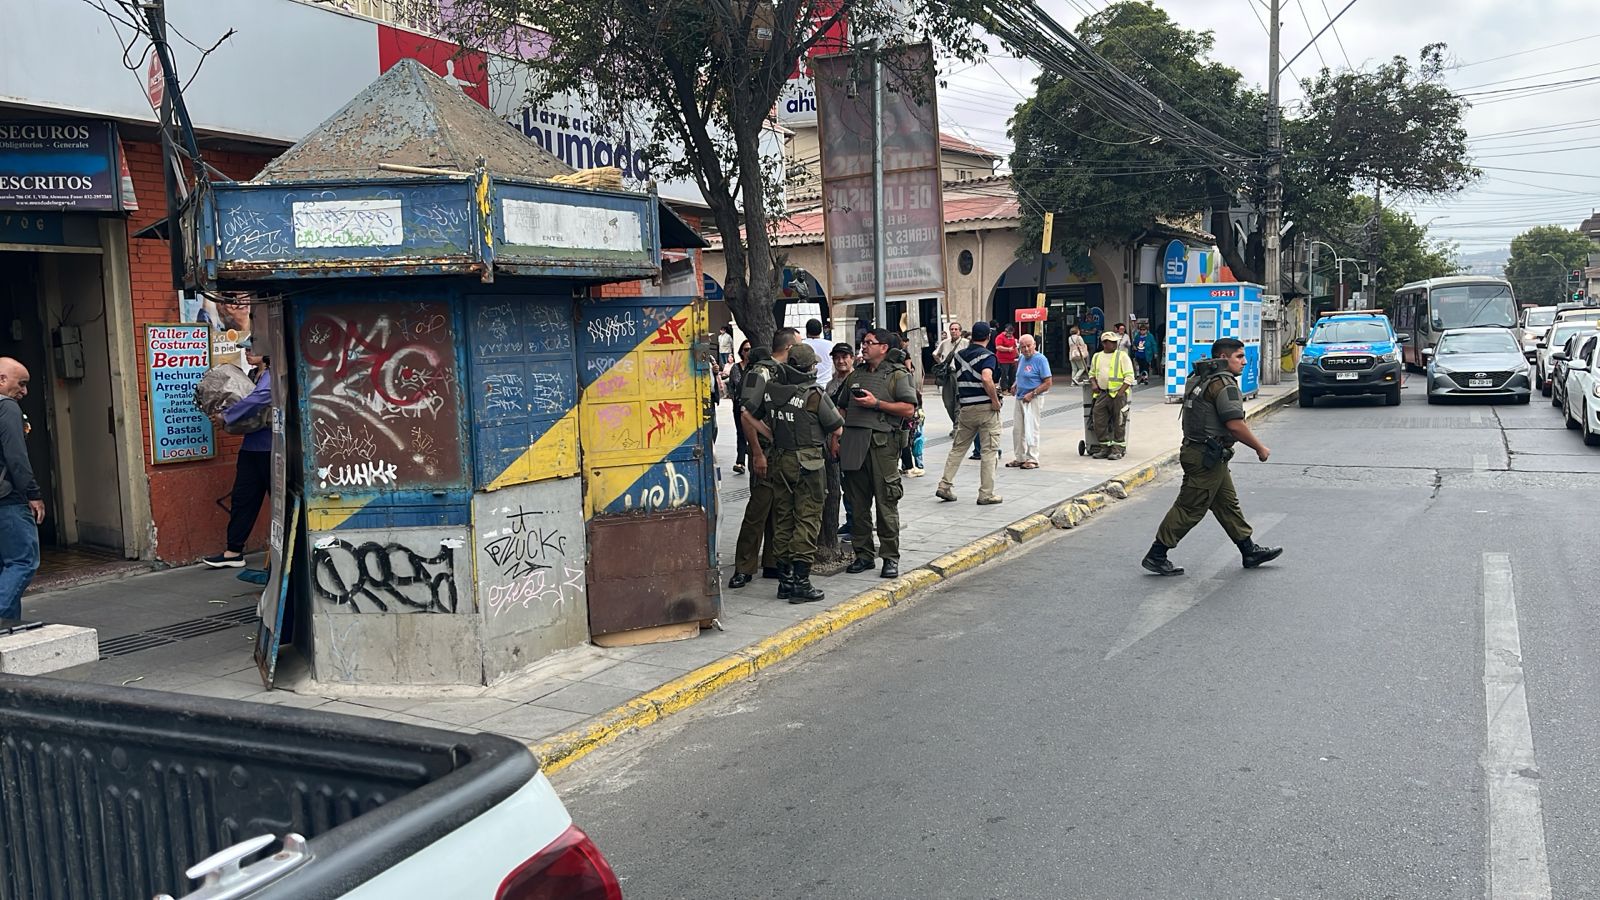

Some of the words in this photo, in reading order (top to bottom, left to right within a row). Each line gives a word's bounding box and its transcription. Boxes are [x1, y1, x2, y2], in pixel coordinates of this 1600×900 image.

[0, 125, 89, 140] SEGUROS
[0, 176, 92, 190] ESCRITOS
[1167, 256, 1184, 275] sb
[1021, 312, 1038, 320] Claro
[150, 329, 188, 339] Taller
[193, 328, 207, 338] de
[151, 340, 207, 350] Costuras
[221, 343, 237, 355] piel
[152, 352, 208, 368] Berni
[156, 381, 198, 393] Arreglo
[164, 415, 203, 424] Cierres
[167, 425, 202, 434] Bastas
[160, 434, 208, 446] Overlock
[162, 449, 198, 458] LOCAL
[201, 445, 208, 454] 8
